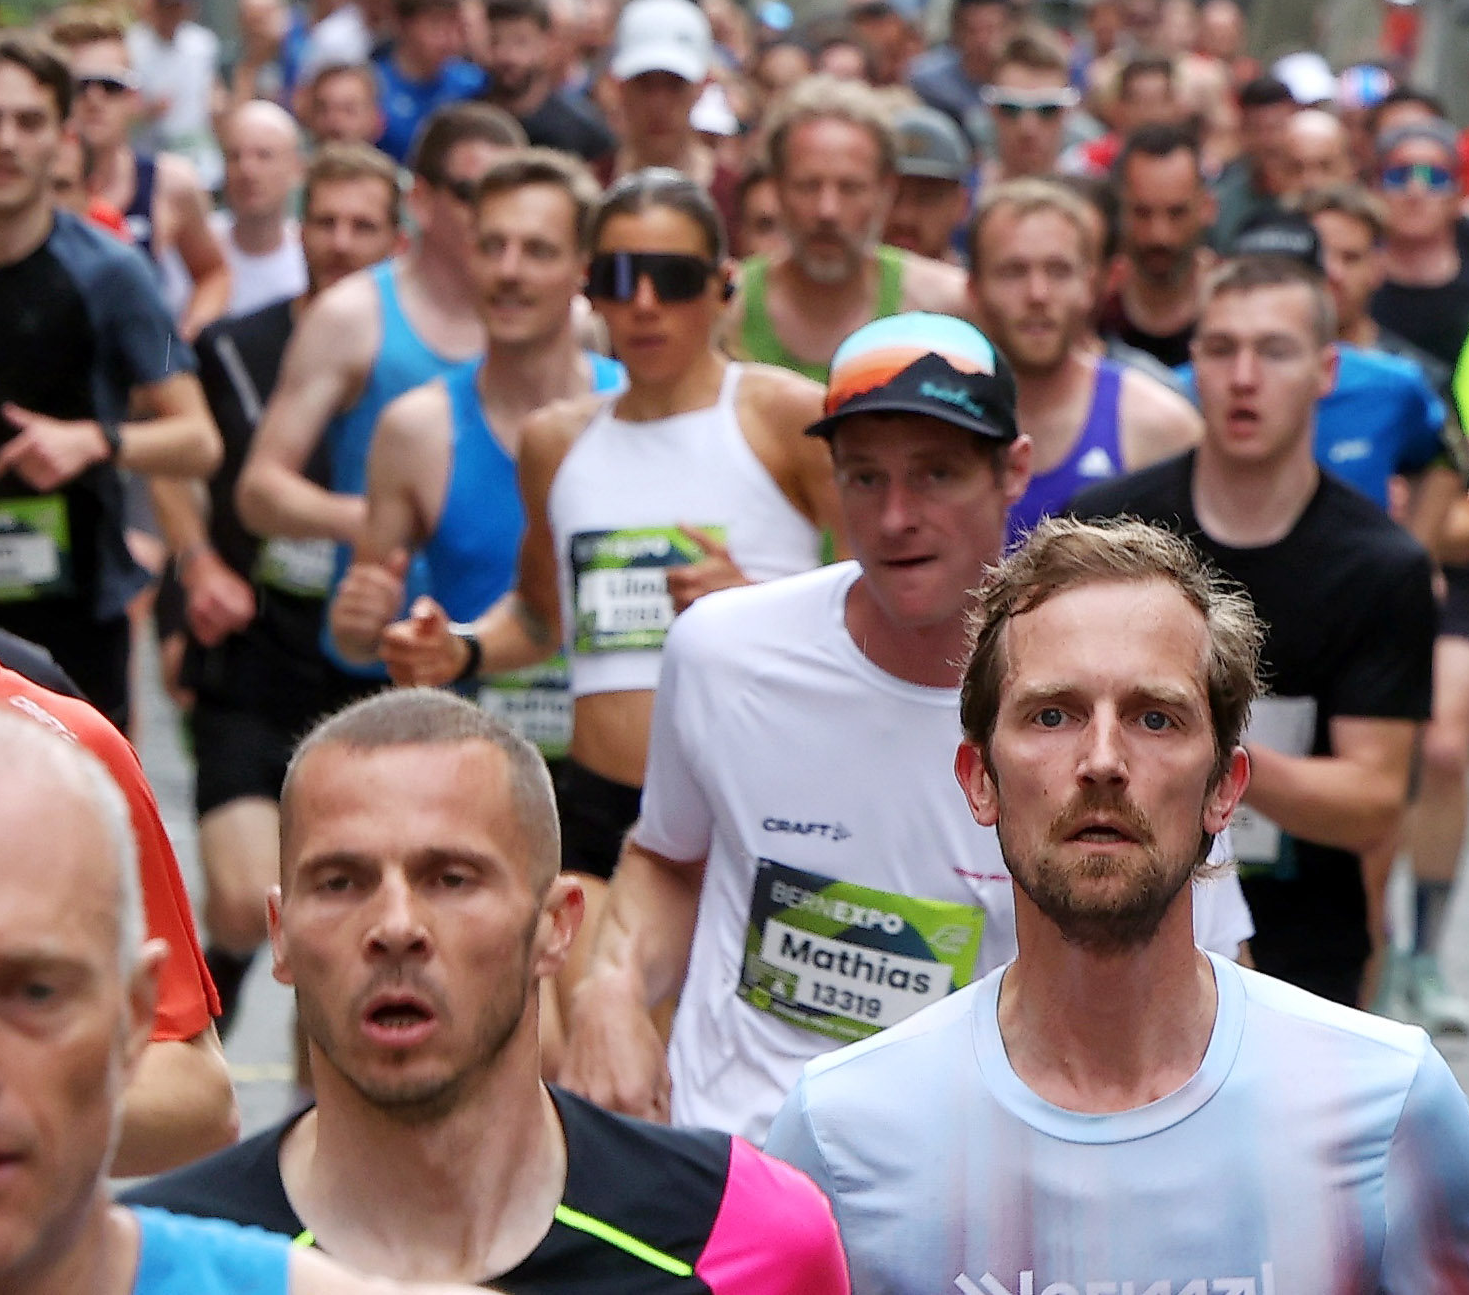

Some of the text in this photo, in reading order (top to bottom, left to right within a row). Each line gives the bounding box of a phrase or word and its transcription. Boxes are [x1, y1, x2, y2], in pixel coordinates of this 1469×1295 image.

[762, 817, 830, 837] CRAFT
[780, 933, 931, 995] Mathias
[812, 983, 881, 1018] 13319
